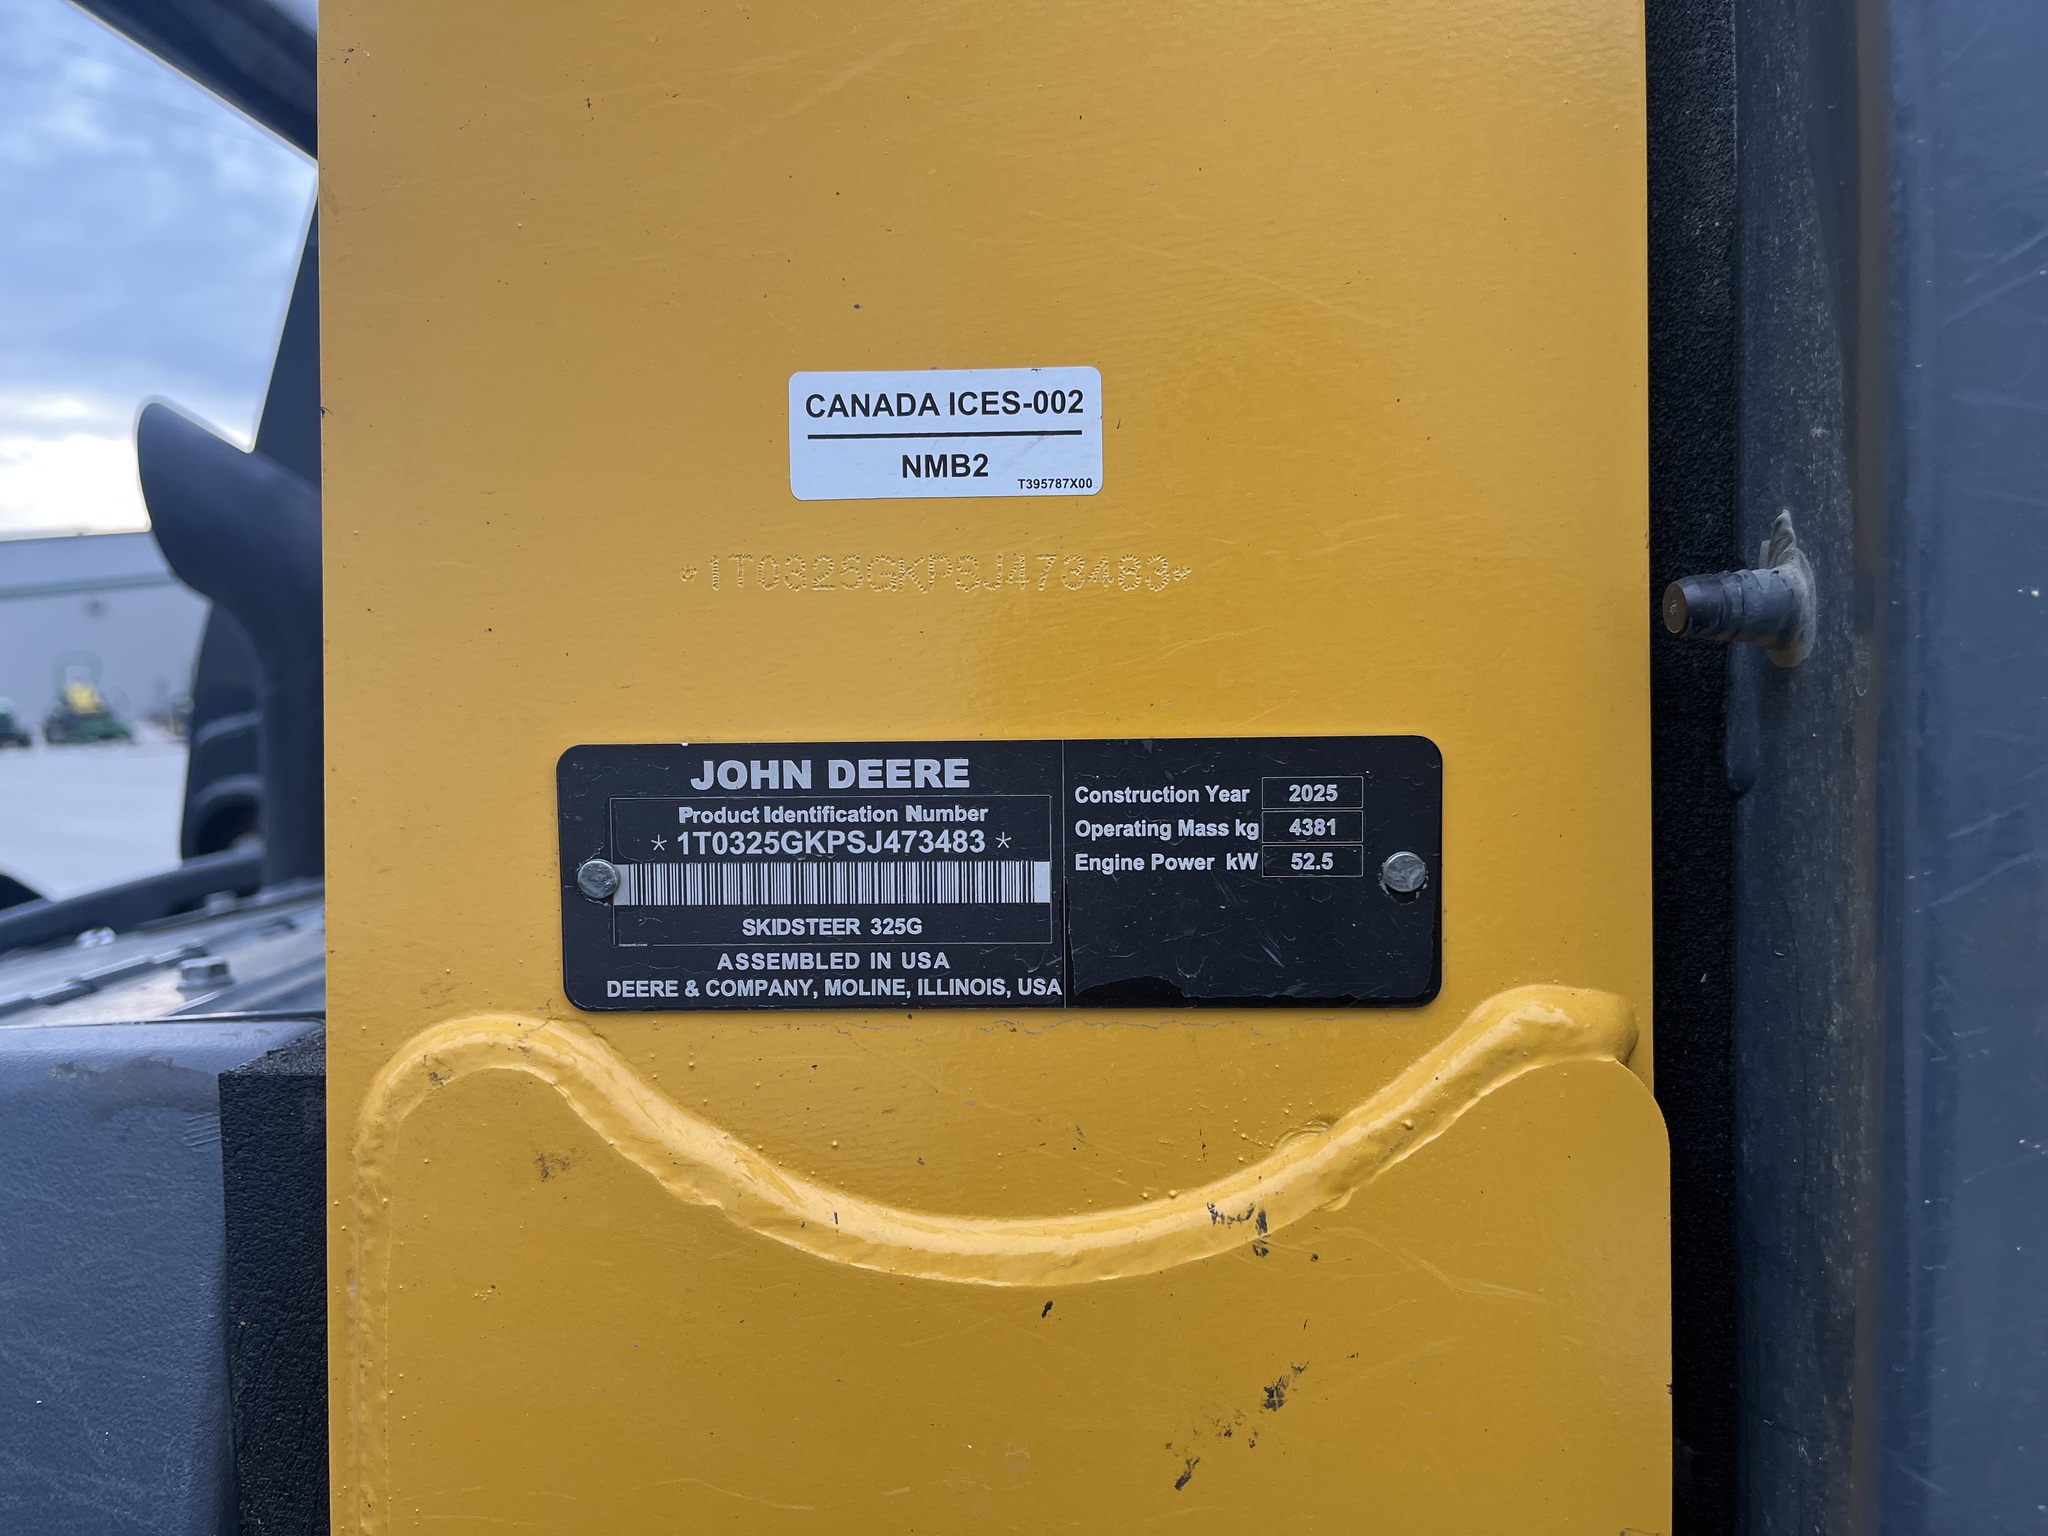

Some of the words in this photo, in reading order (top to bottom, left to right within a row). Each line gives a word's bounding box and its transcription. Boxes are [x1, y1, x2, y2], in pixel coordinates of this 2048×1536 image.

[805, 392, 940, 418] CANADA
[949, 389, 1084, 416] ICES-002
[902, 453, 989, 479] NMB2
[1017, 478, 1093, 490] T395787X00
[690, 760, 812, 790] JOHN
[828, 758, 970, 789] DEERE
[1074, 785, 1200, 804] Construction
[1205, 785, 1250, 803] Year
[1289, 784, 1338, 802] 2025
[678, 806, 759, 824] Product
[764, 805, 898, 823] Identification
[905, 805, 988, 822] Number
[1074, 819, 1172, 841] Operating
[1178, 820, 1229, 837] Mass
[1235, 820, 1259, 841] kg
[1289, 818, 1337, 836] 4381
[677, 829, 986, 855] 1T0325GKPSJ473483
[1074, 853, 1145, 875] Engine
[1151, 853, 1215, 871] Power
[1226, 853, 1259, 871] kW
[1290, 852, 1334, 870] 52.5
[741, 918, 861, 936] SKIDSTEER
[870, 917, 923, 936] 325G
[717, 952, 861, 970] ASSEMBLED
[870, 952, 892, 970] IN
[901, 951, 950, 970] USA
[607, 980, 678, 998] DEERE
[684, 980, 700, 997] &
[705, 979, 818, 999] COMPANY,
[825, 978, 911, 998] MOLINE,
[917, 978, 1011, 998] ILLINOIS,
[1018, 978, 1062, 996] USA
